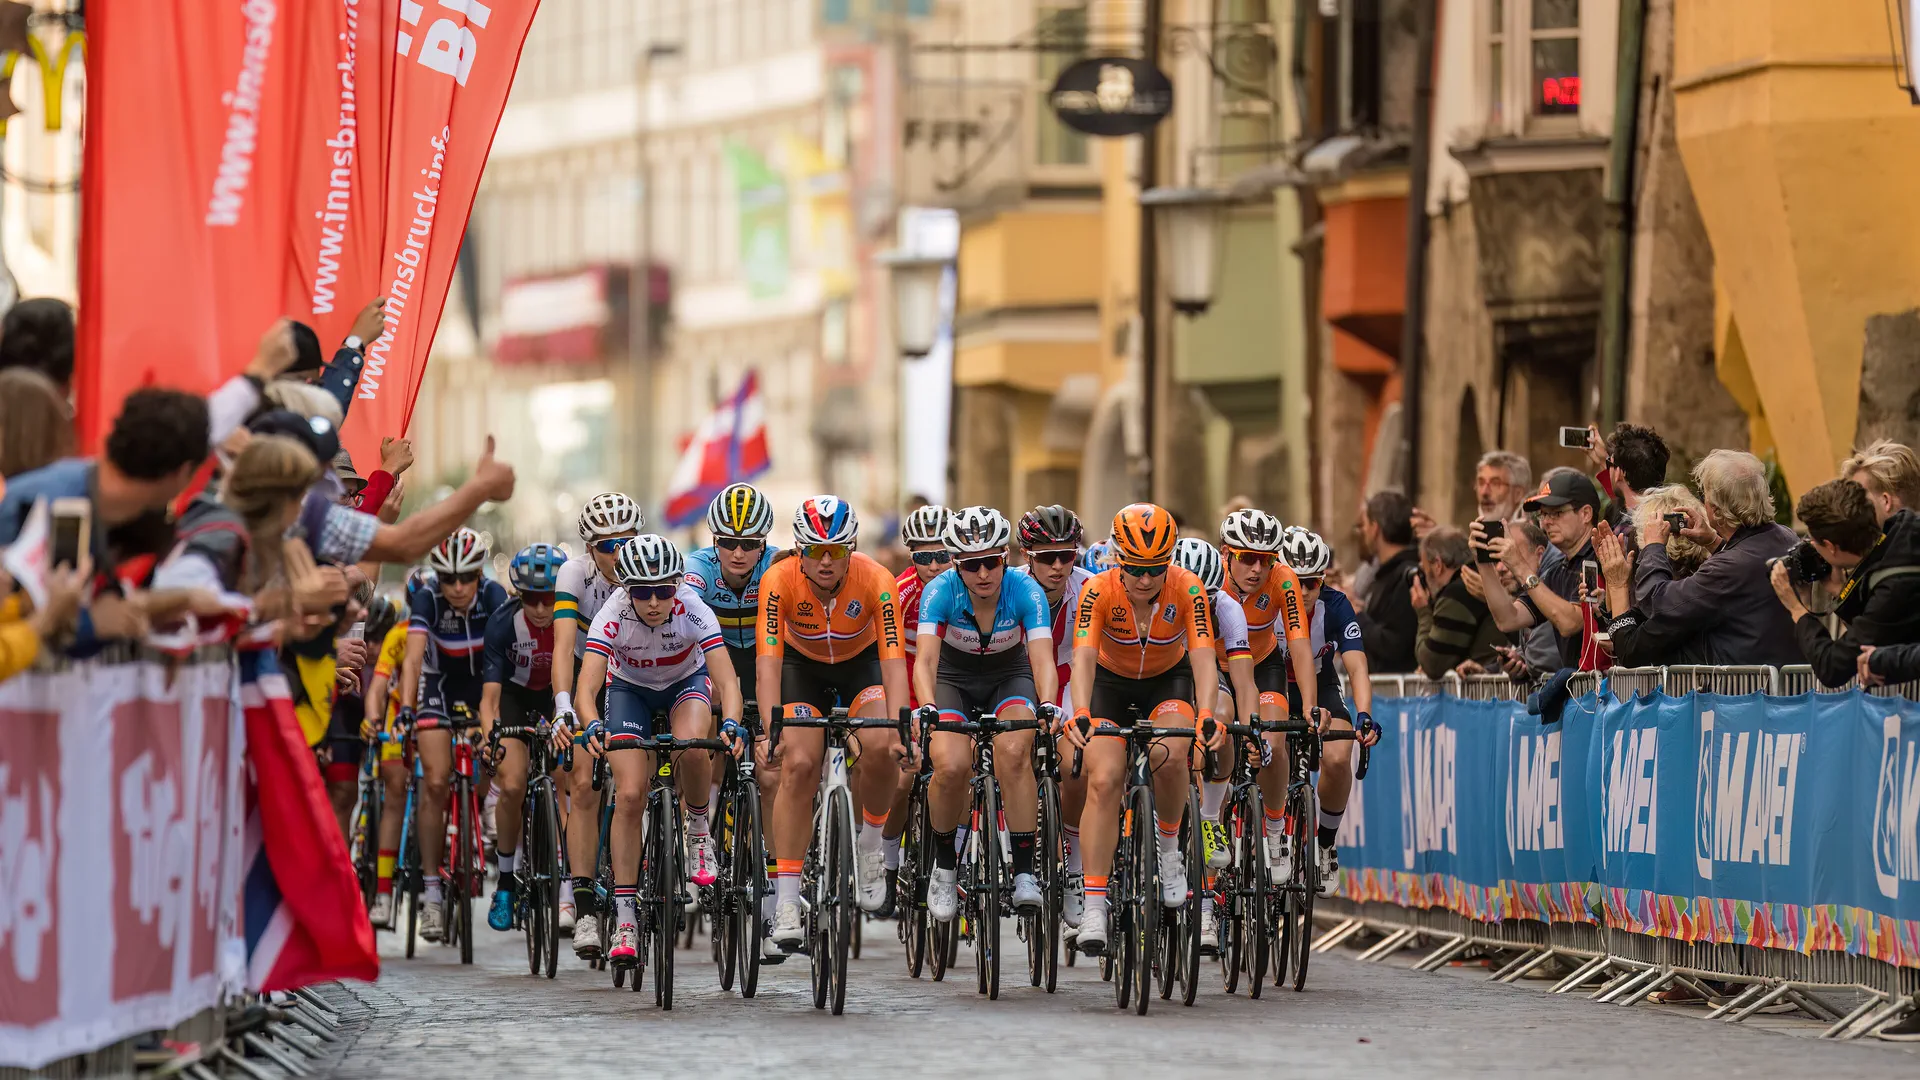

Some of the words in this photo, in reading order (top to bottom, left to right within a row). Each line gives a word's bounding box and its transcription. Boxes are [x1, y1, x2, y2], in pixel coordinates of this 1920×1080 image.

[766, 591, 781, 635] centric
[882, 602, 899, 648] centric
[1079, 588, 1100, 629] centric
[1193, 595, 1210, 638] centric
[1285, 590, 1301, 631] centric
[1714, 729, 1801, 866] MAPEI
